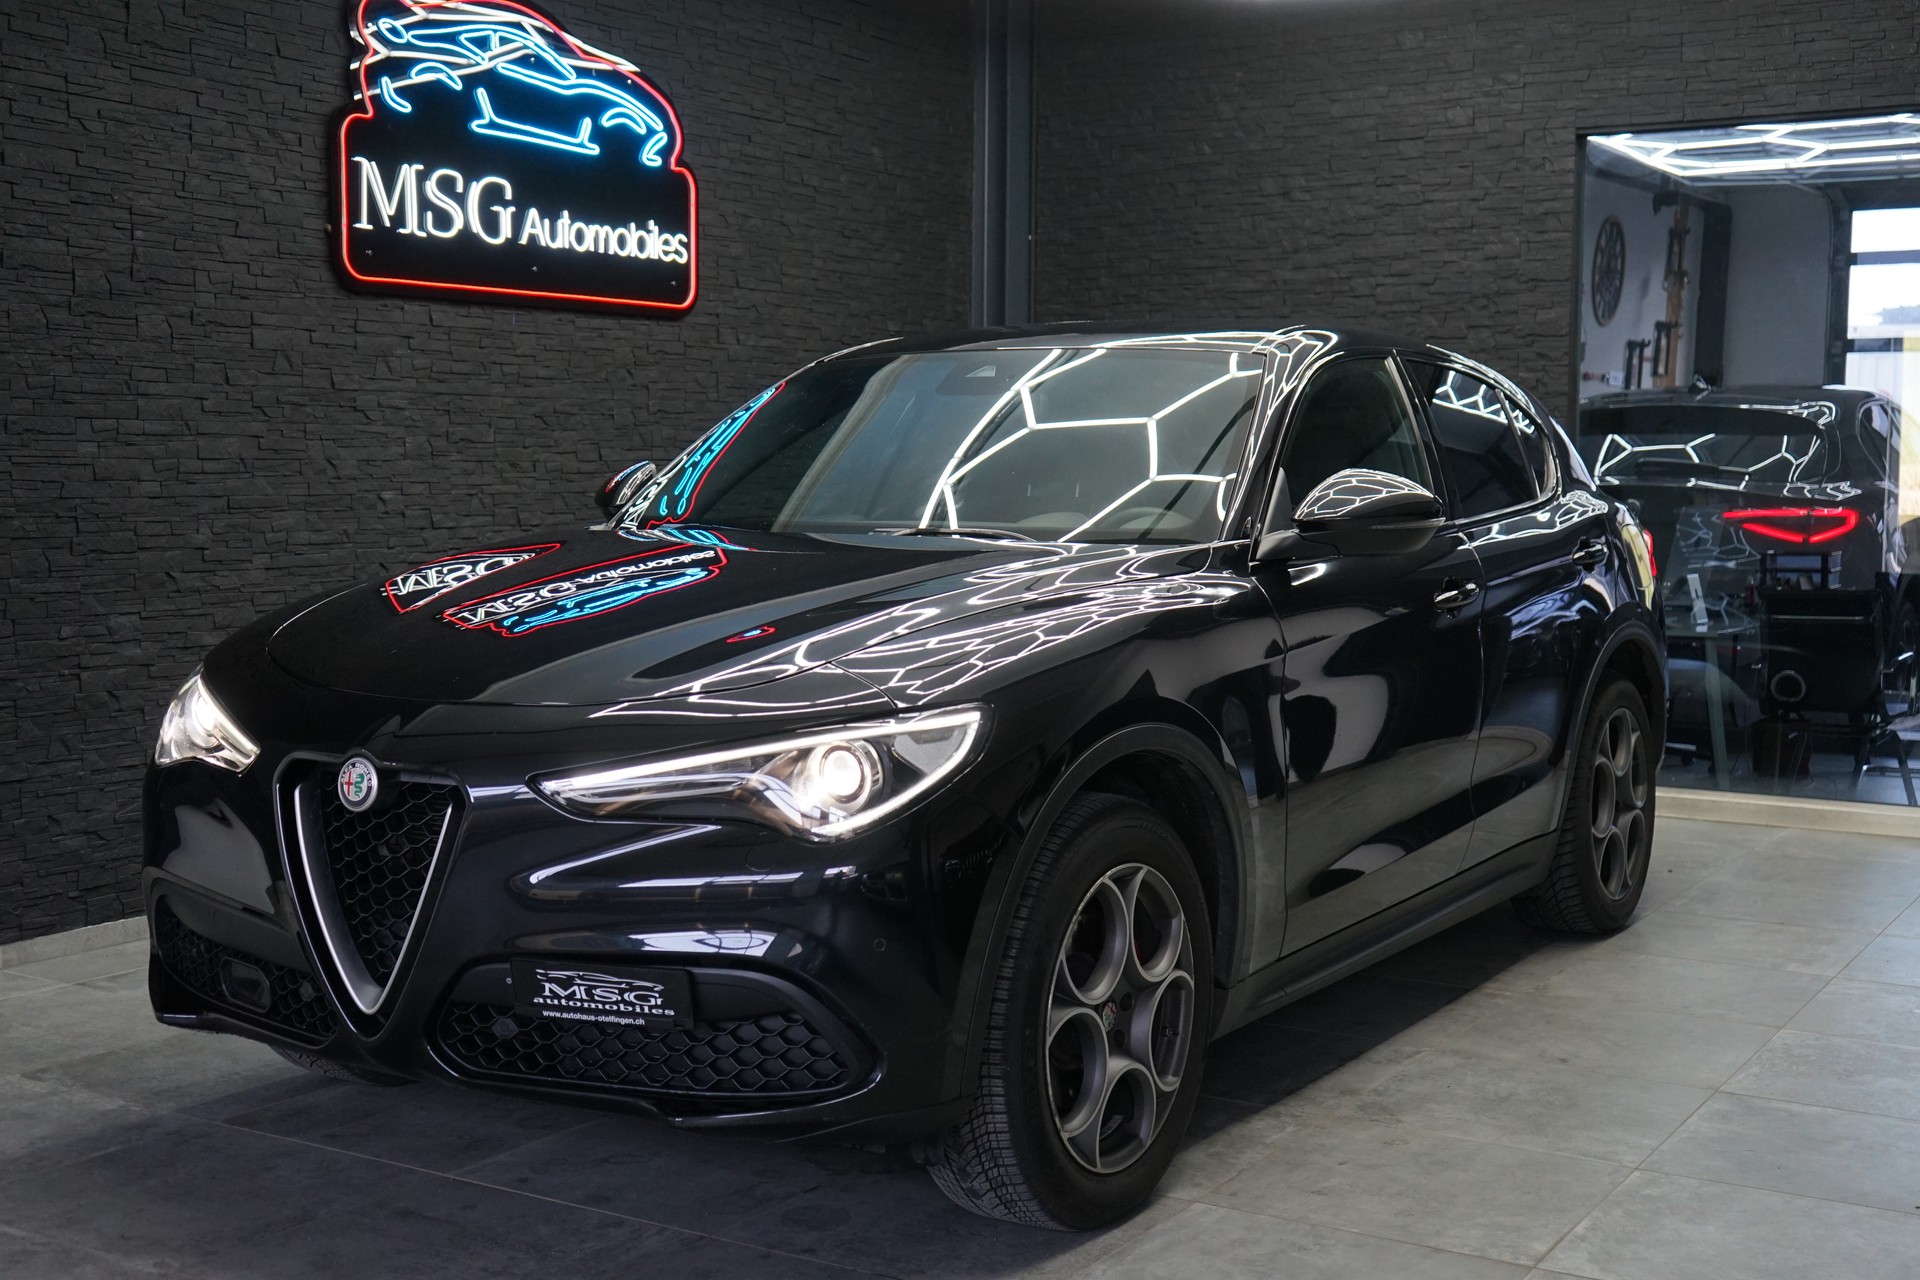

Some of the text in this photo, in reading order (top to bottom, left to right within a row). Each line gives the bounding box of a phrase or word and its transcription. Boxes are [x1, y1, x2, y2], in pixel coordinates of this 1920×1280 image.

[351, 157, 689, 264] MSG Automobiles
[341, 762, 372, 787] ALFA ROMEO
[533, 996, 675, 1016] automobiles
[541, 982, 664, 1006] MSG
[542, 1010, 645, 1026] www.autohaus-otelfingen.ch
